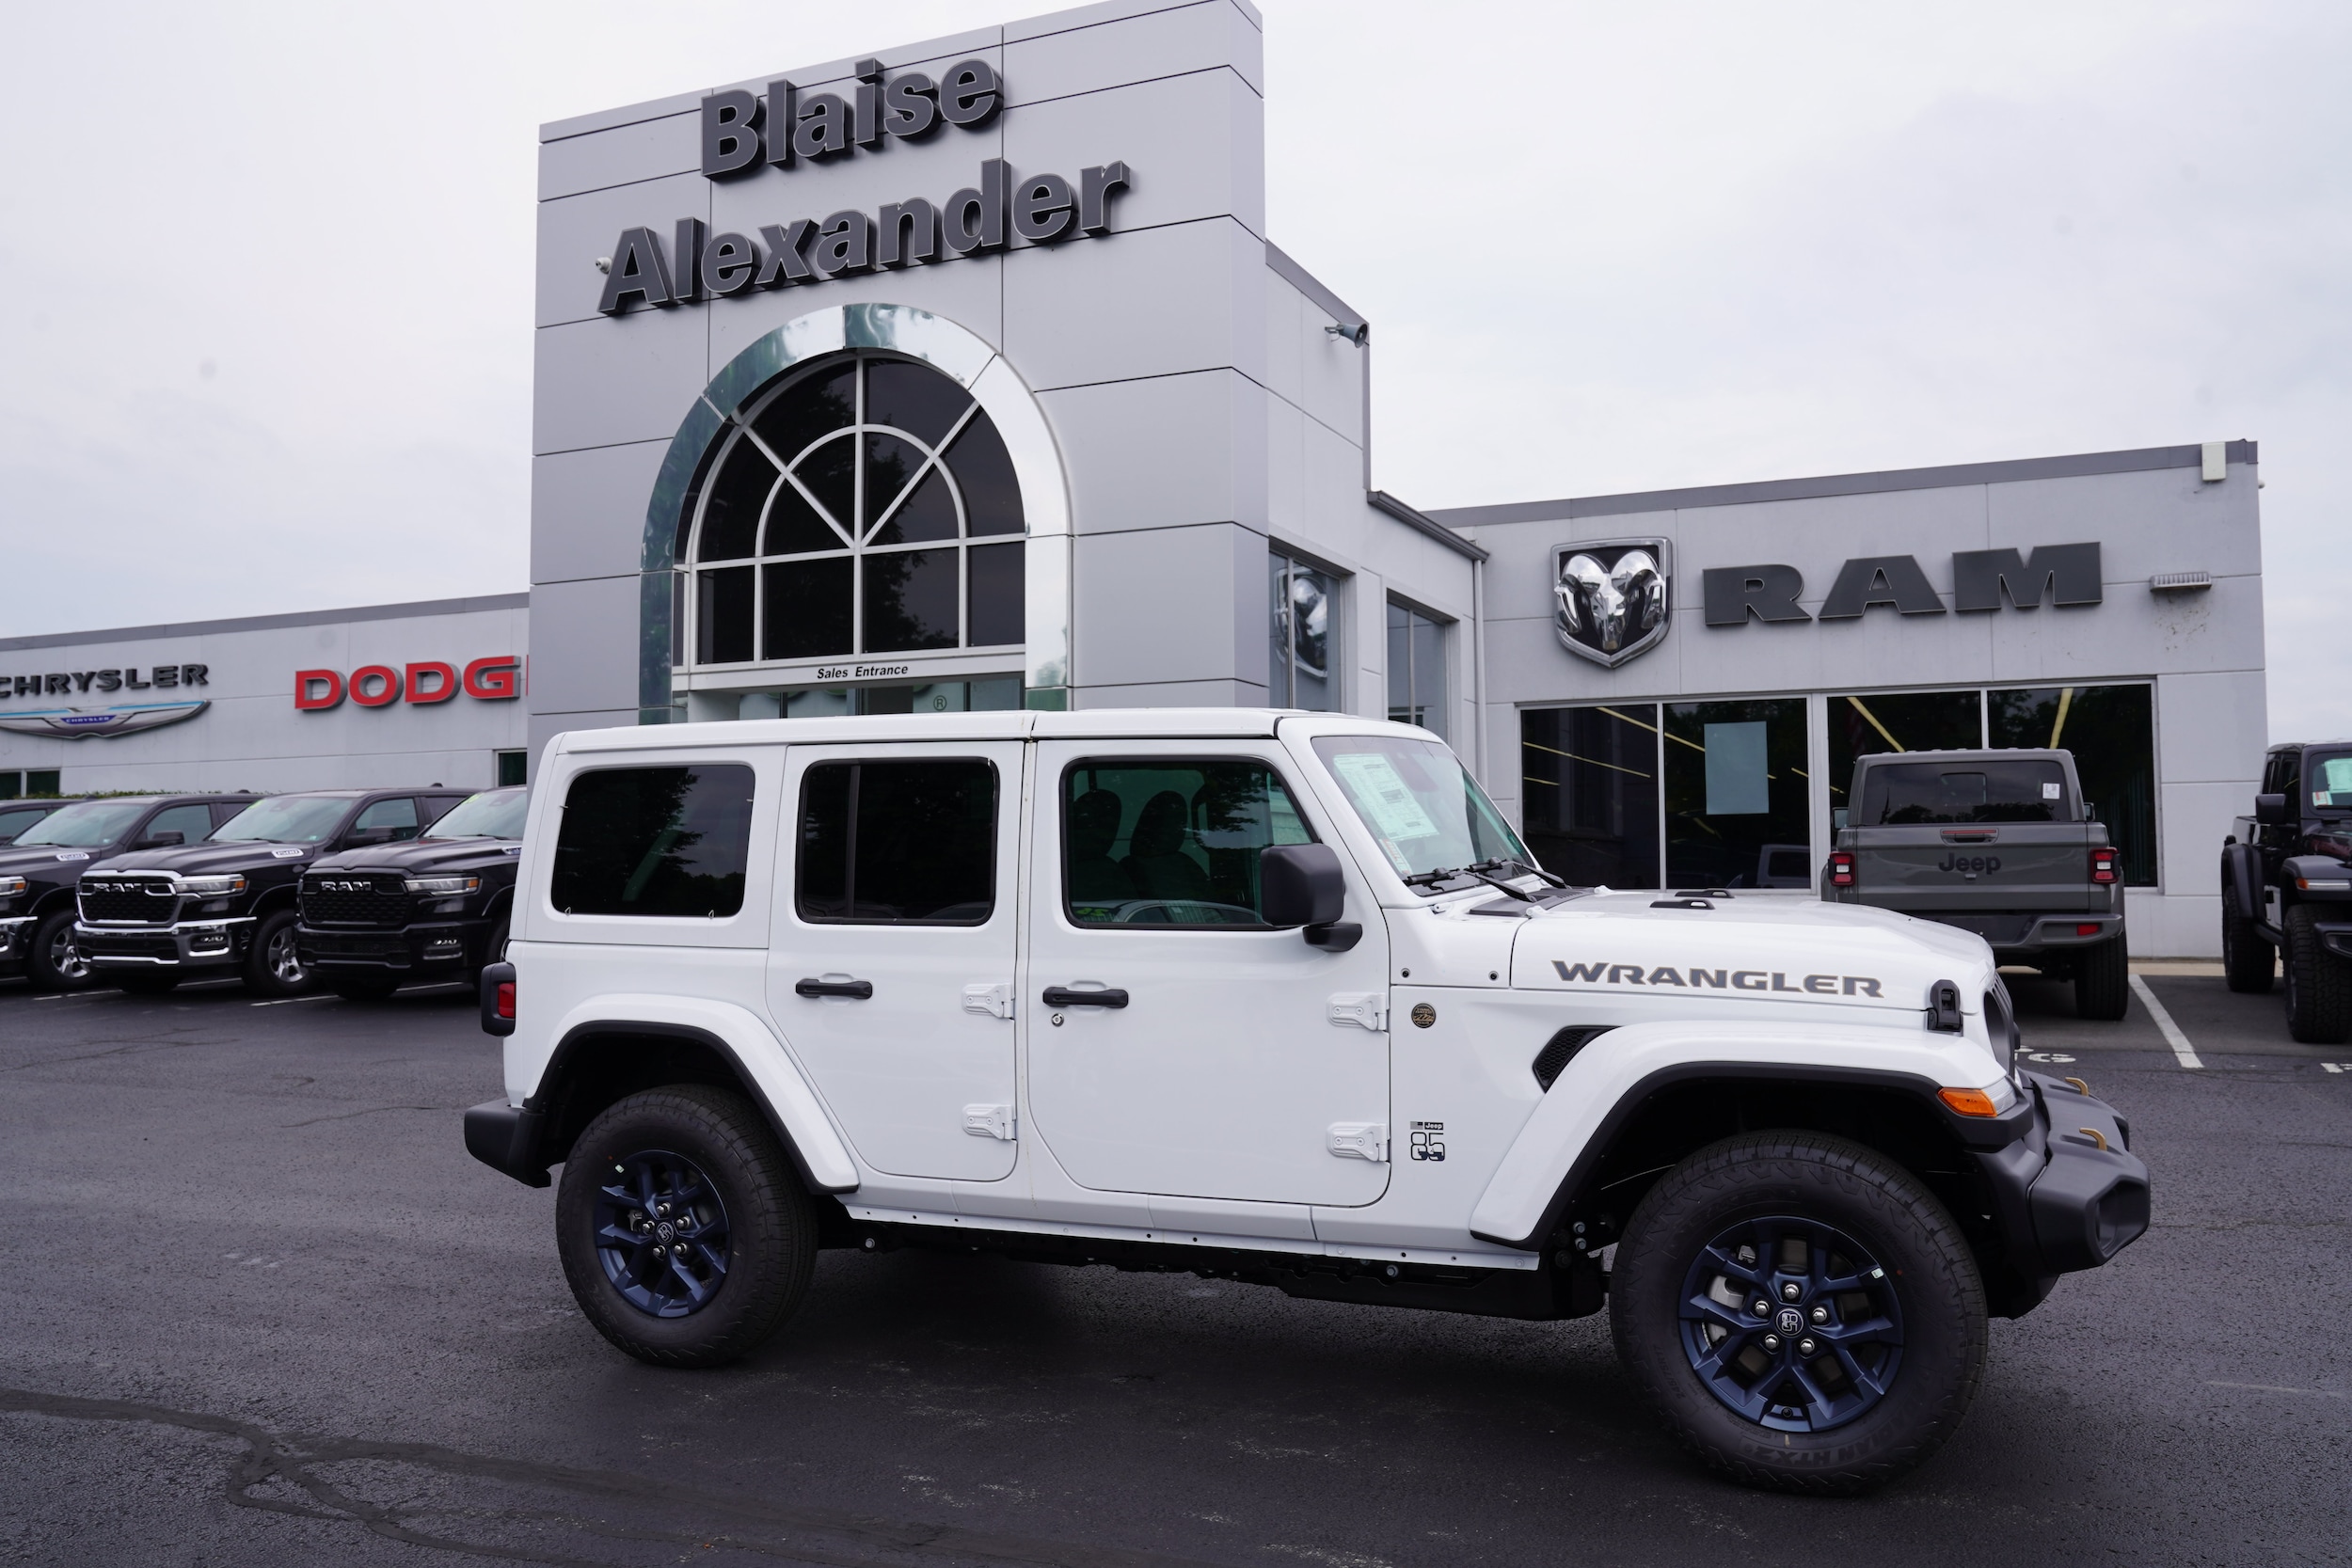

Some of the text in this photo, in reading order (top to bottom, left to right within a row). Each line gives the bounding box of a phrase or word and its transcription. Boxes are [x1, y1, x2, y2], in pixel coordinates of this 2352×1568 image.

[701, 58, 1004, 182] Blaise
[596, 158, 1130, 315] Alexander
[1702, 541, 2104, 626] RAM
[294, 655, 529, 712] DODG
[817, 665, 909, 680] Sales Entrance
[66, 716, 110, 724] CHRYSLER
[1938, 852, 2001, 875] Jeep
[321, 880, 372, 892] RAM
[1550, 959, 1885, 999] WRANGLER
[1425, 1122, 1443, 1131] Jeep
[1410, 1132, 1446, 1162] 85
